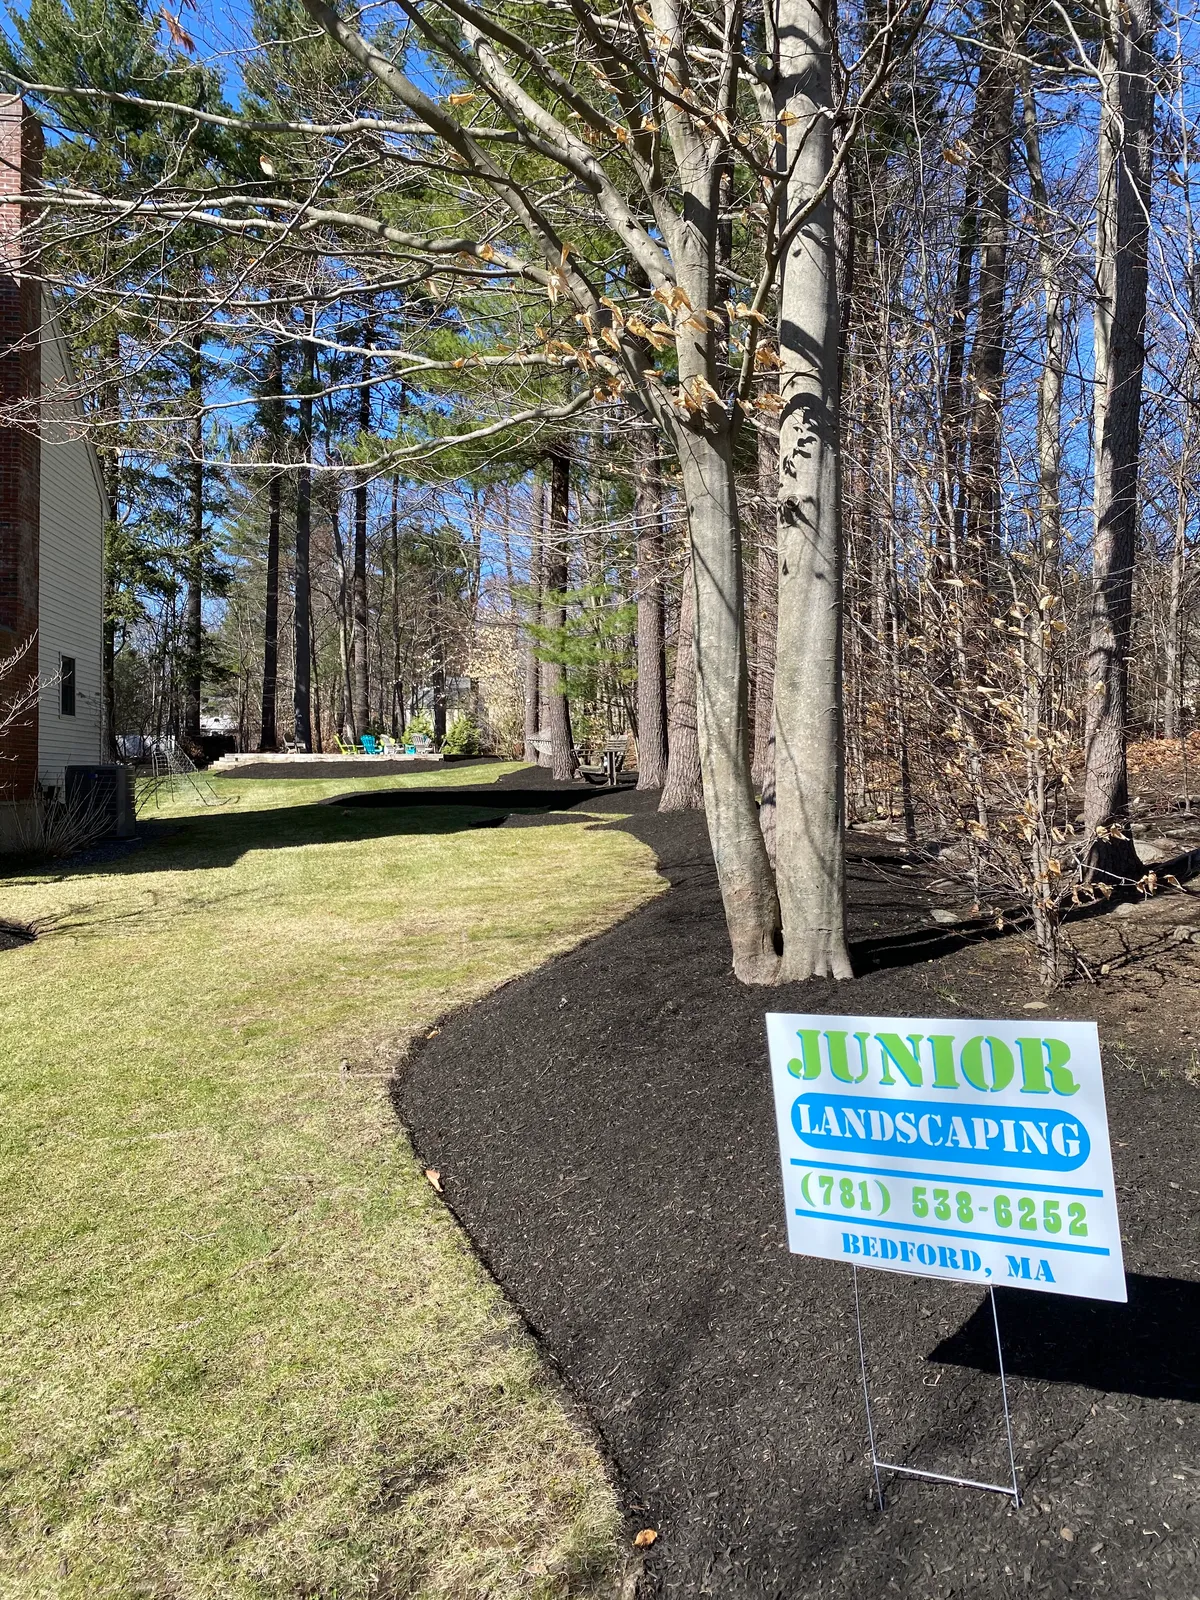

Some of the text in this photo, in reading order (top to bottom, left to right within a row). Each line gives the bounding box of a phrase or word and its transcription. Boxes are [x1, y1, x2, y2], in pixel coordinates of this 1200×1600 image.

[787, 1030, 1080, 1097] JUNIOR
[797, 1103, 1081, 1158] LANDSCAPING
[801, 1171, 1088, 1237] (781) 538-6252
[841, 1232, 1057, 1284] BEDFORD, MA
